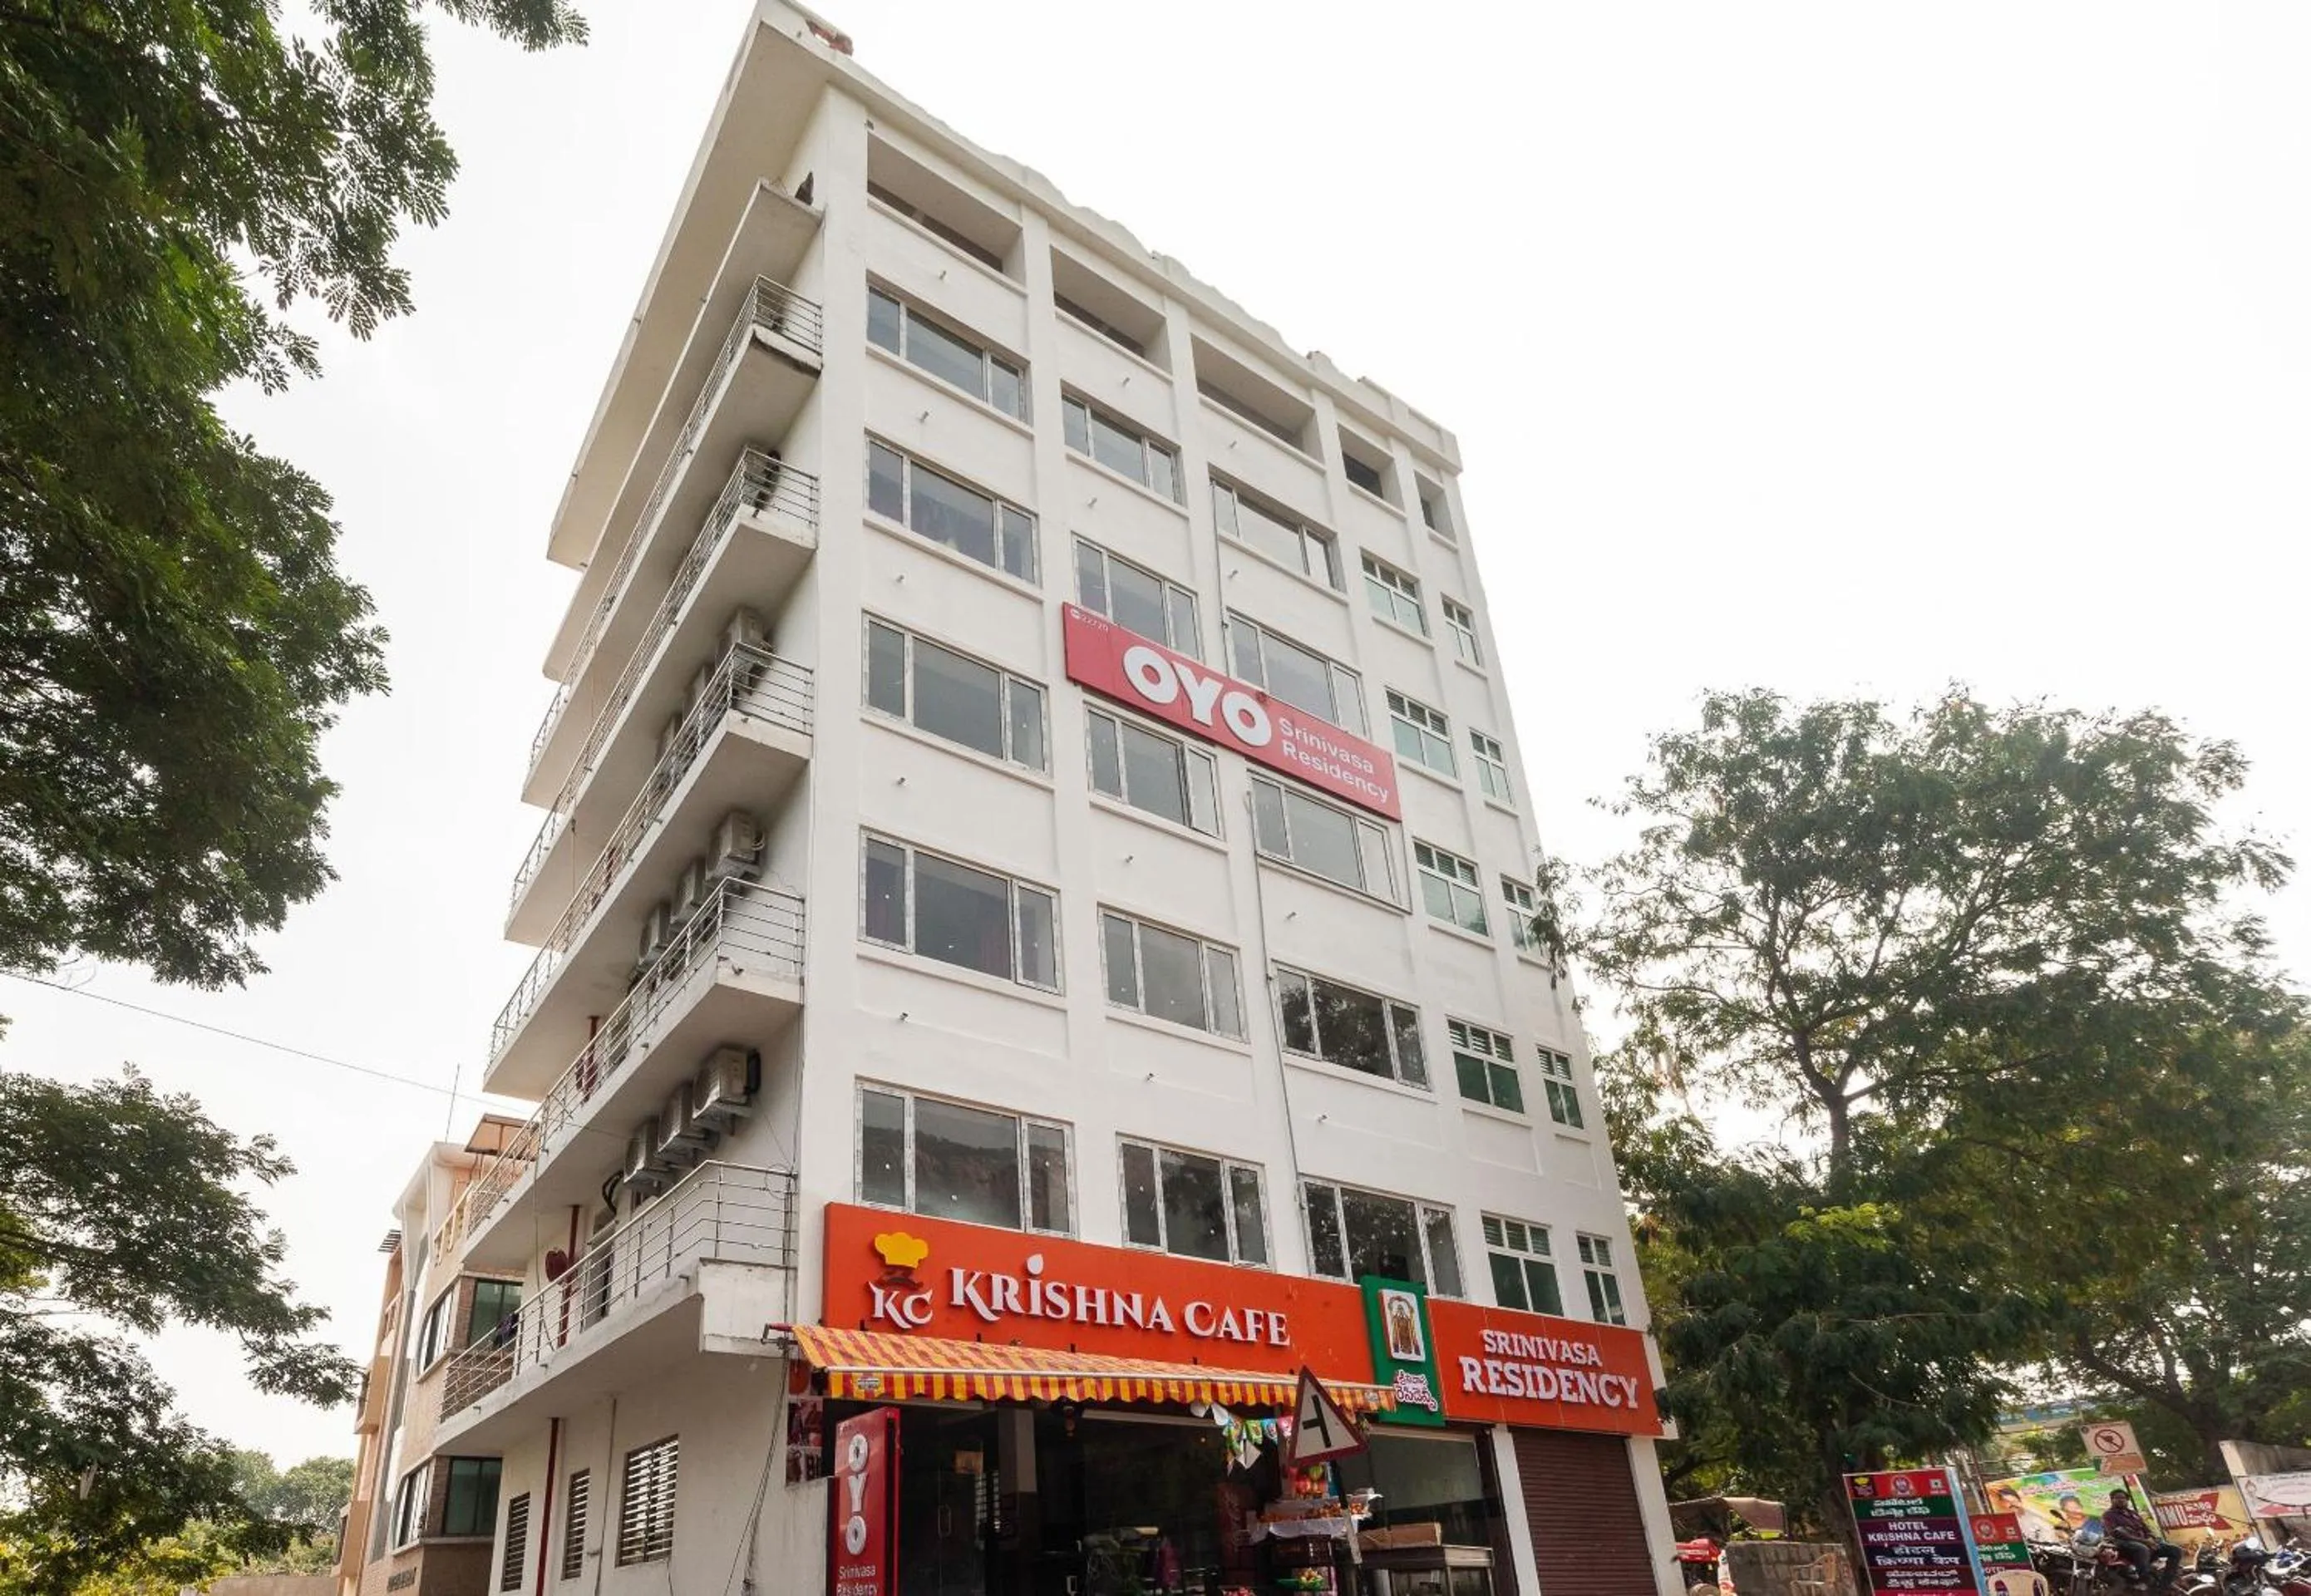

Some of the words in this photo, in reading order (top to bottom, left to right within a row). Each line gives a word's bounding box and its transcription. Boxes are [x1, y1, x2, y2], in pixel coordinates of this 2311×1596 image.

[1122, 645, 1273, 747] OYO
[1279, 717, 1375, 775] Srinivasa
[1282, 741, 1390, 805] Residency
[867, 1280, 934, 1329] KC
[1184, 1301, 1290, 1347] CAFE
[1481, 1328, 1603, 1367] SRINIVASA
[1458, 1356, 1638, 1410] RESIDENCY
[845, 1433, 869, 1556] OYO
[1867, 1532, 1922, 1542] KRISHNA
[1924, 1530, 1956, 1540] CAFE
[1888, 1521, 1929, 1531] HOTEL
[838, 1564, 877, 1580] Srinivasa
